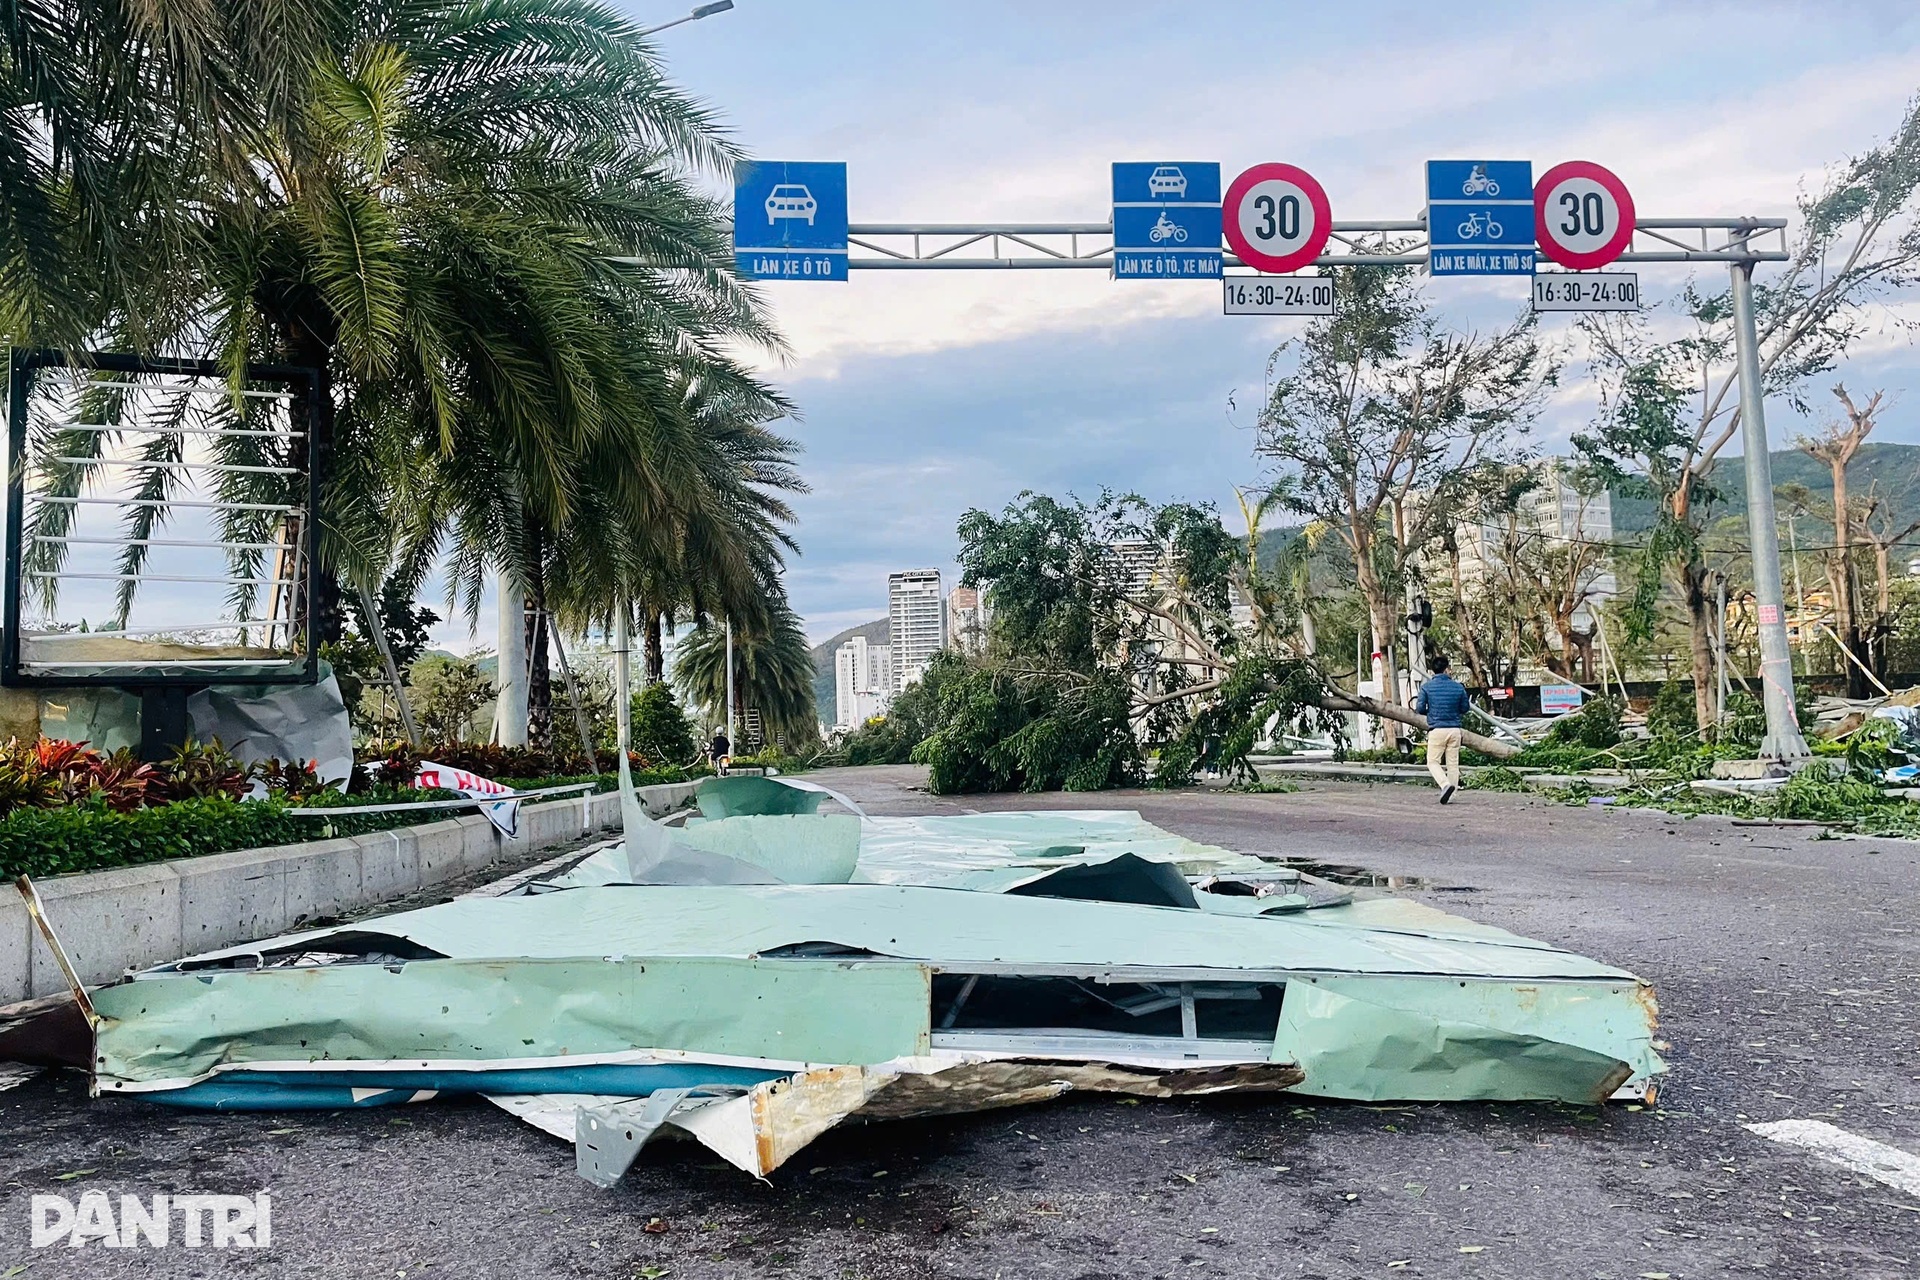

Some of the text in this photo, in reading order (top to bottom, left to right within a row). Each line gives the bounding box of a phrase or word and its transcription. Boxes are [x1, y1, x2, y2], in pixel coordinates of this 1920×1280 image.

[1254, 195, 1300, 240] 30
[1559, 192, 1604, 236] 30
[753, 256, 832, 275] LÀN XE Ô TÔ
[1118, 256, 1220, 275] LÀN XE Ô TÔ, XE MÁY
[1434, 253, 1534, 271] LÀN XE MÁY, XE THÔ SƠ
[1227, 285, 1331, 306] 16:30-24:00
[1536, 282, 1635, 302] 16:30-24:00
